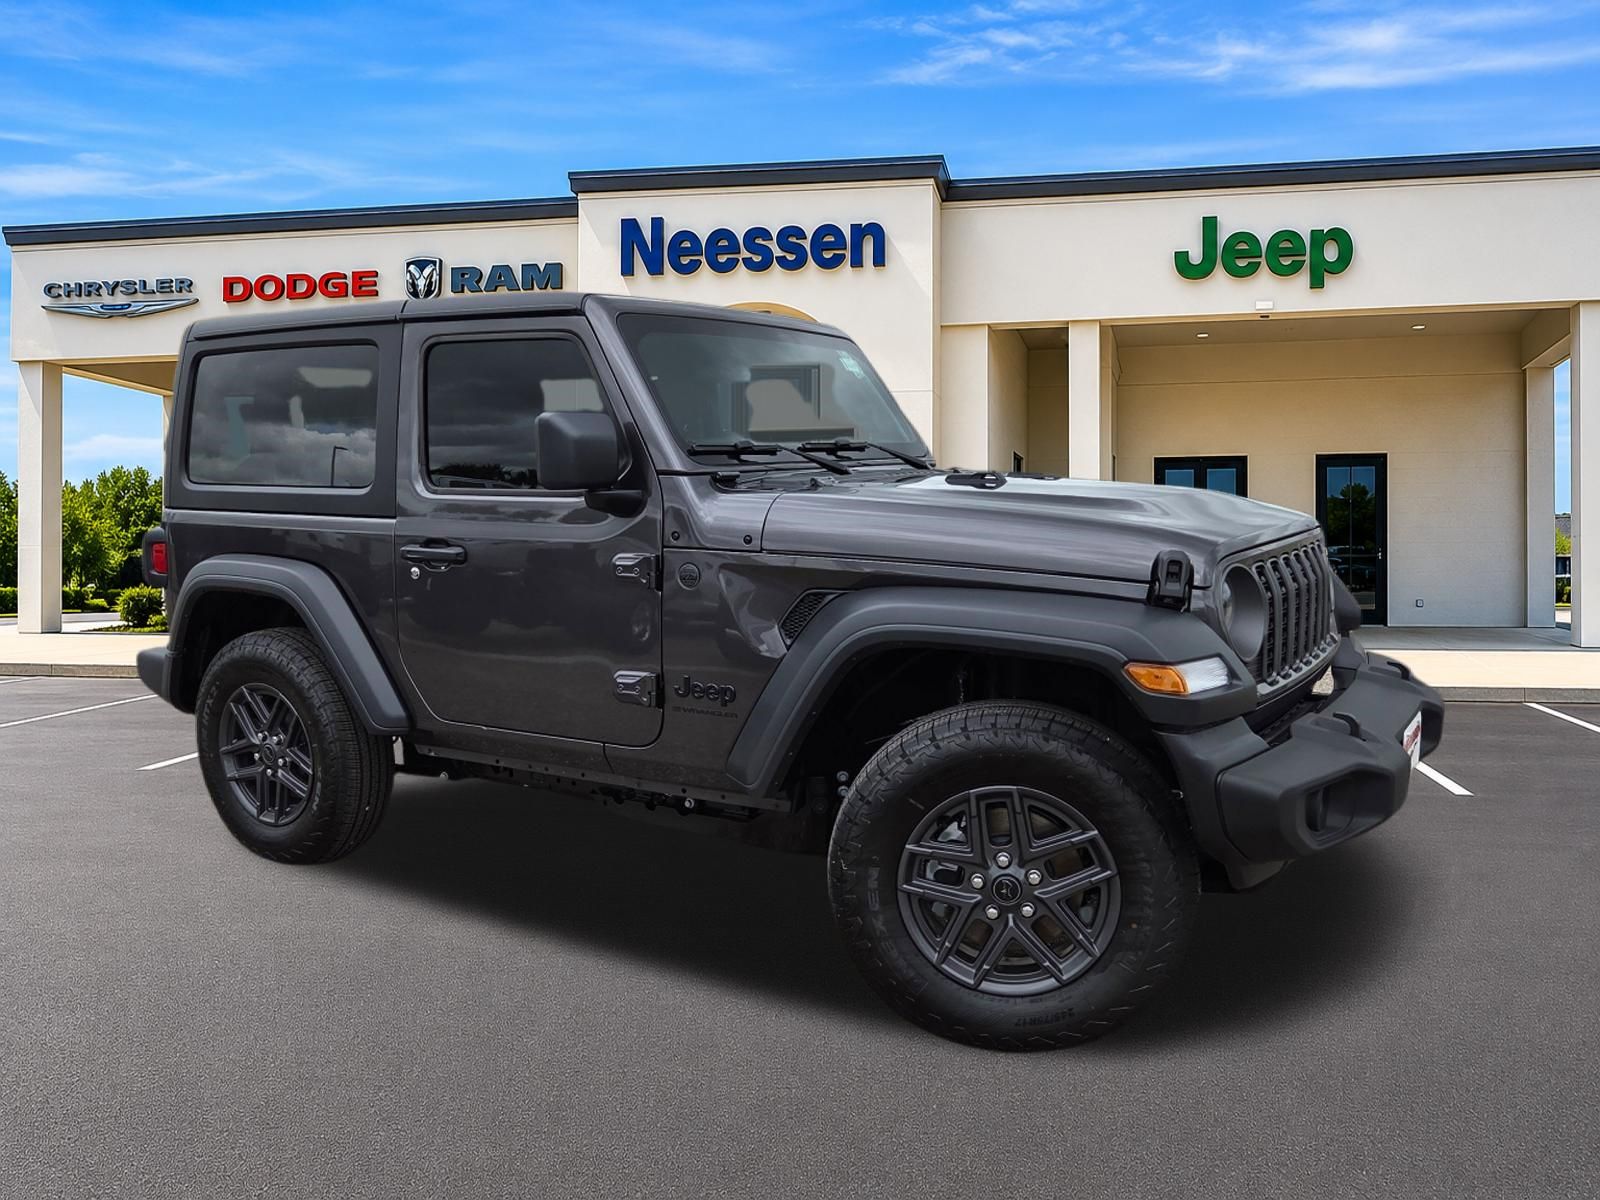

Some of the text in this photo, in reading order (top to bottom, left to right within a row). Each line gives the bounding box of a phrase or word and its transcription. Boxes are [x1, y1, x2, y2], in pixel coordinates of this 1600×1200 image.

[620, 216, 886, 276] Neessen
[1174, 216, 1354, 289] Jeep
[44, 278, 194, 298] CHRYSLER
[222, 270, 378, 302] DODGE
[450, 262, 563, 293] RAM
[673, 674, 736, 706] Jeep
